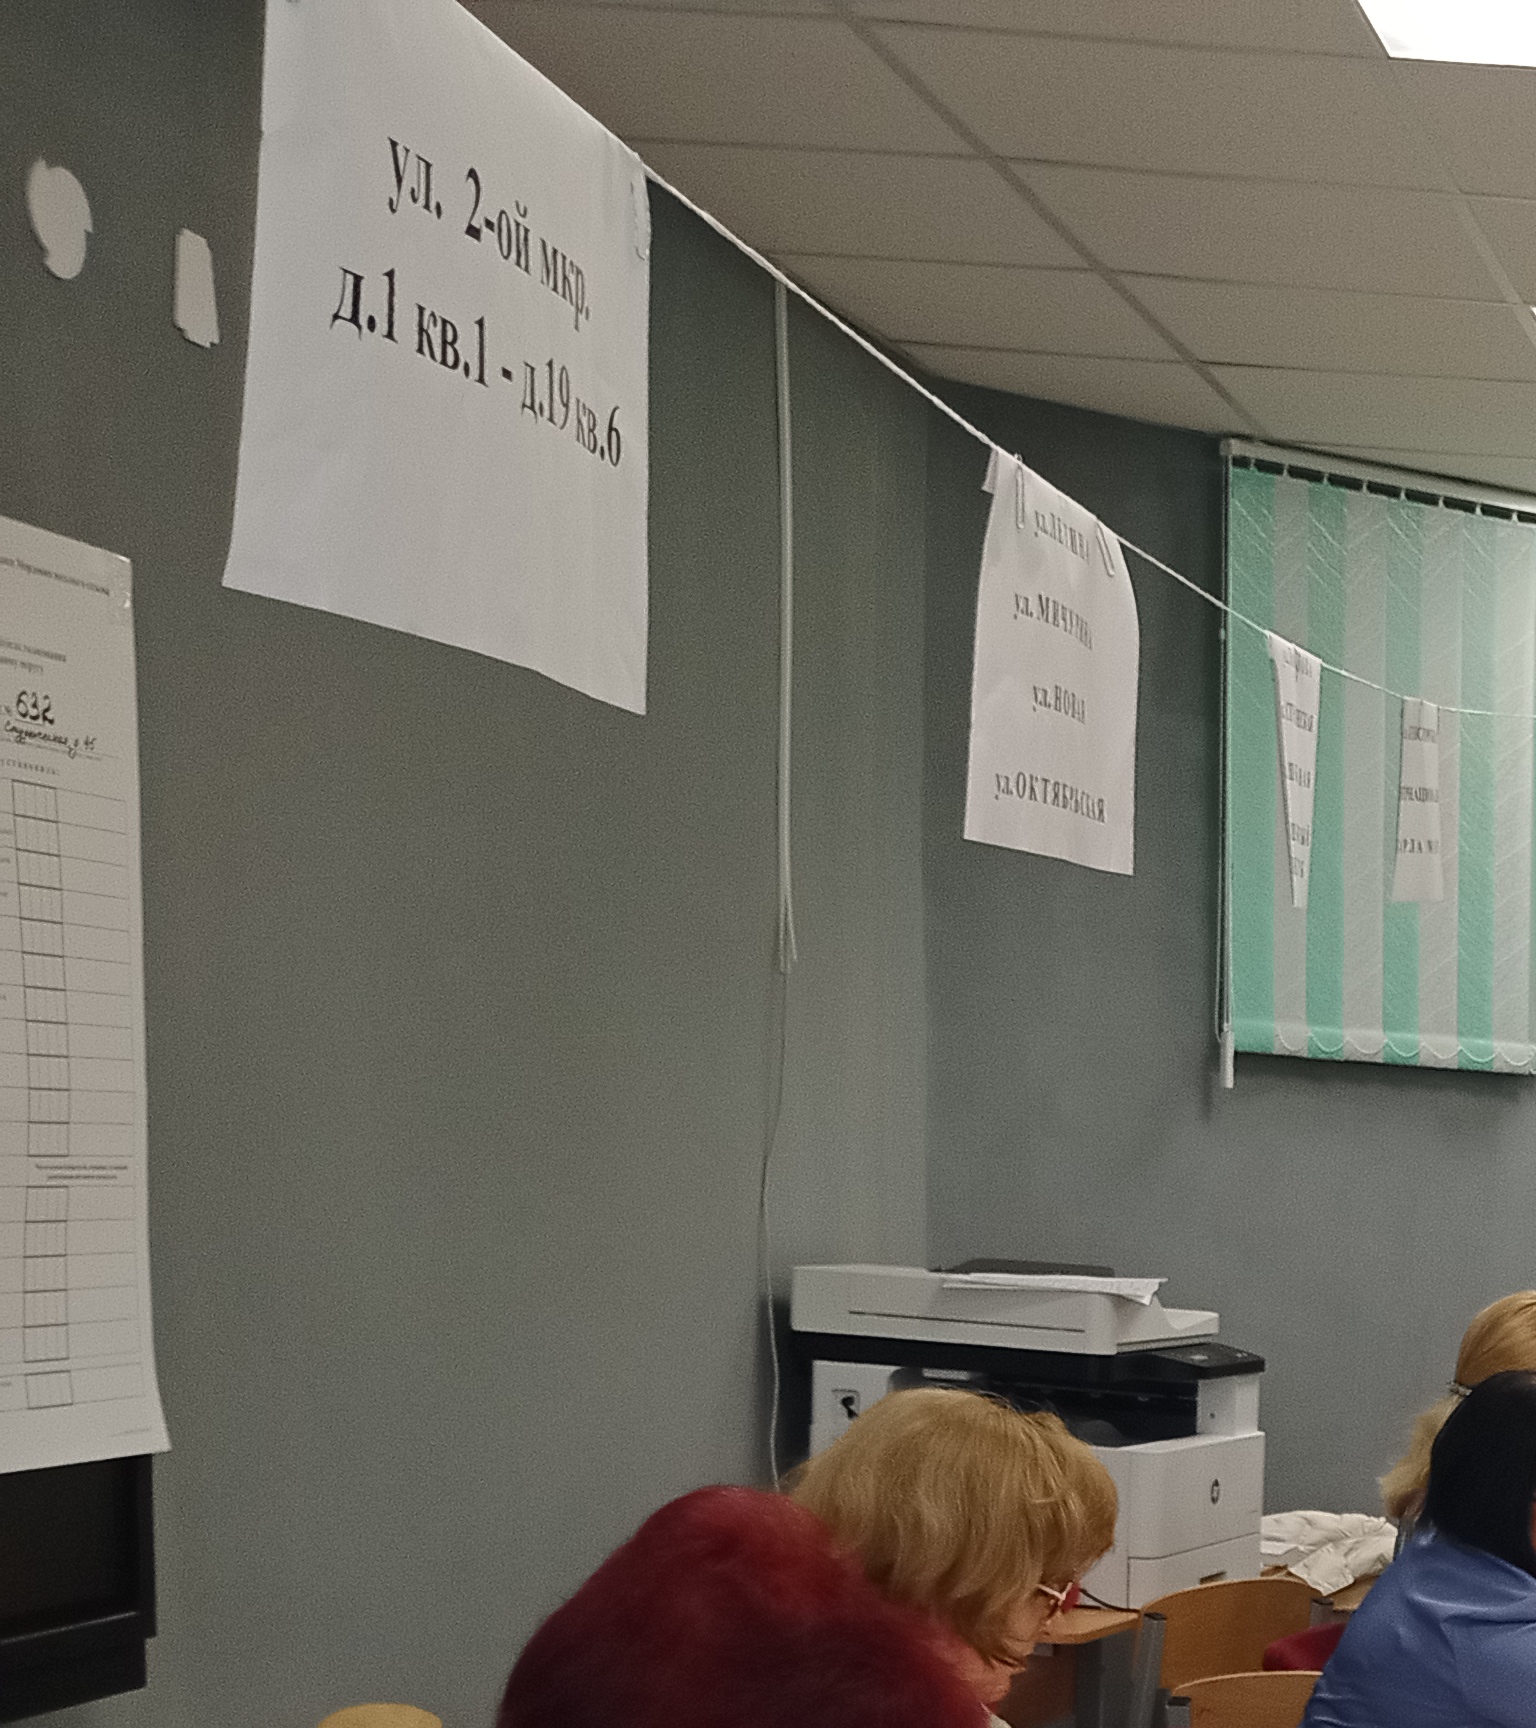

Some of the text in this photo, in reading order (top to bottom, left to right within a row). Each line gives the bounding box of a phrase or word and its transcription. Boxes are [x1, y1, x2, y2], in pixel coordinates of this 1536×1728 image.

[387, 136, 591, 331] ул. 2-ой мкр.
[330, 266, 399, 344] д.1
[415, 302, 489, 388] кв.1
[520, 357, 570, 431] д.19
[575, 398, 622, 469] кв.6
[16, 690, 55, 725] 632
